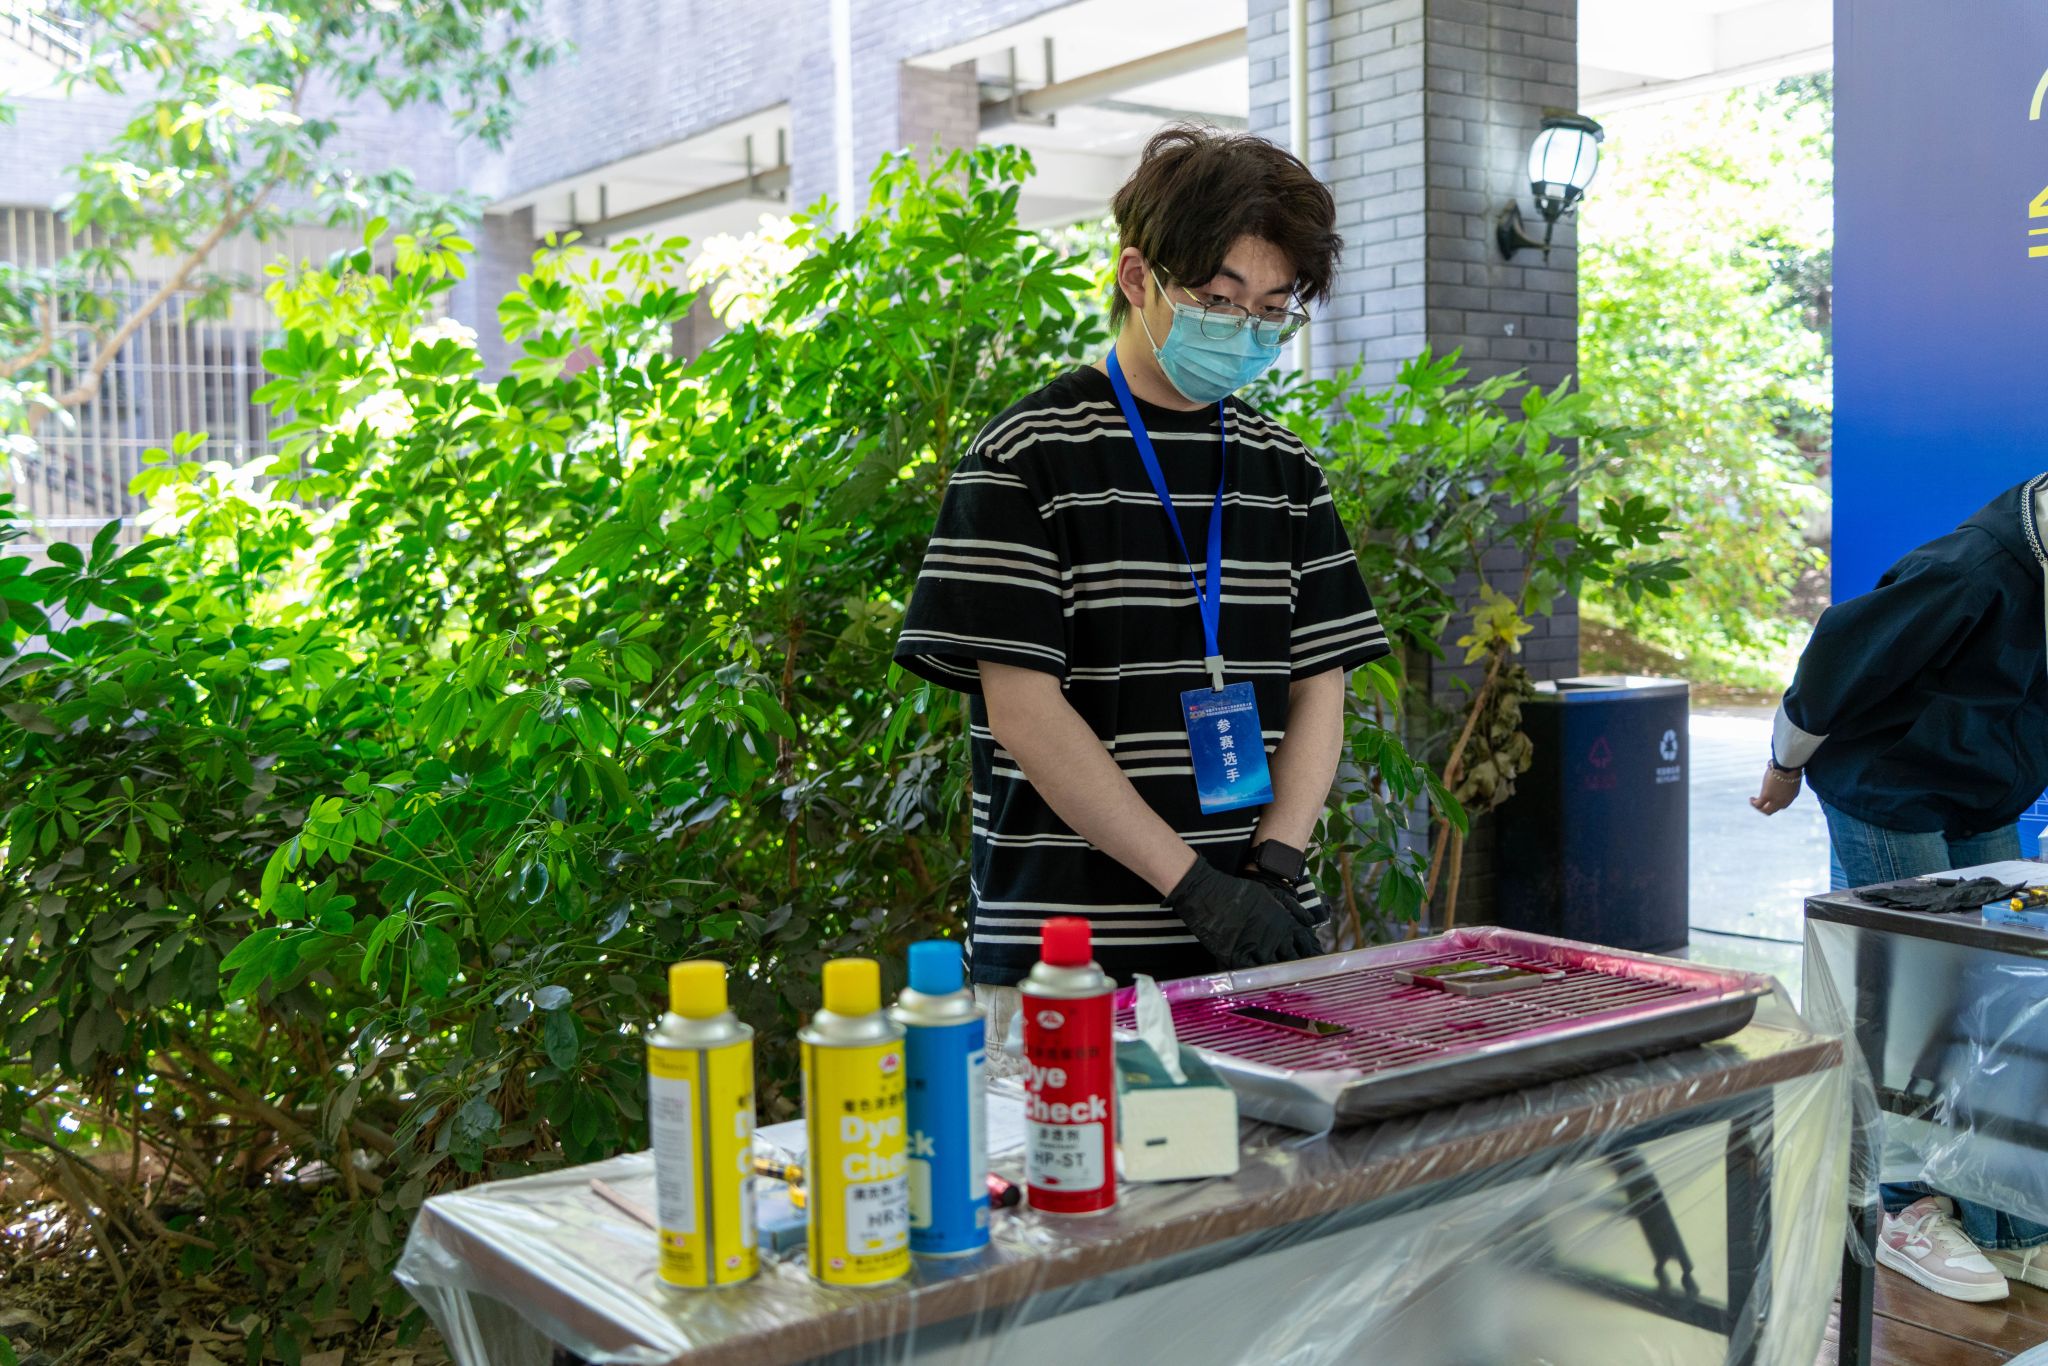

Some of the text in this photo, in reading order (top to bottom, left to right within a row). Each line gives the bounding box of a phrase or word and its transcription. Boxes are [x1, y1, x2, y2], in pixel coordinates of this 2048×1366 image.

[1217, 718, 1240, 783] 参赛选手
[840, 1114, 902, 1148] Dye
[842, 1151, 907, 1180] Che
[1034, 1151, 1087, 1168] HP-ST
